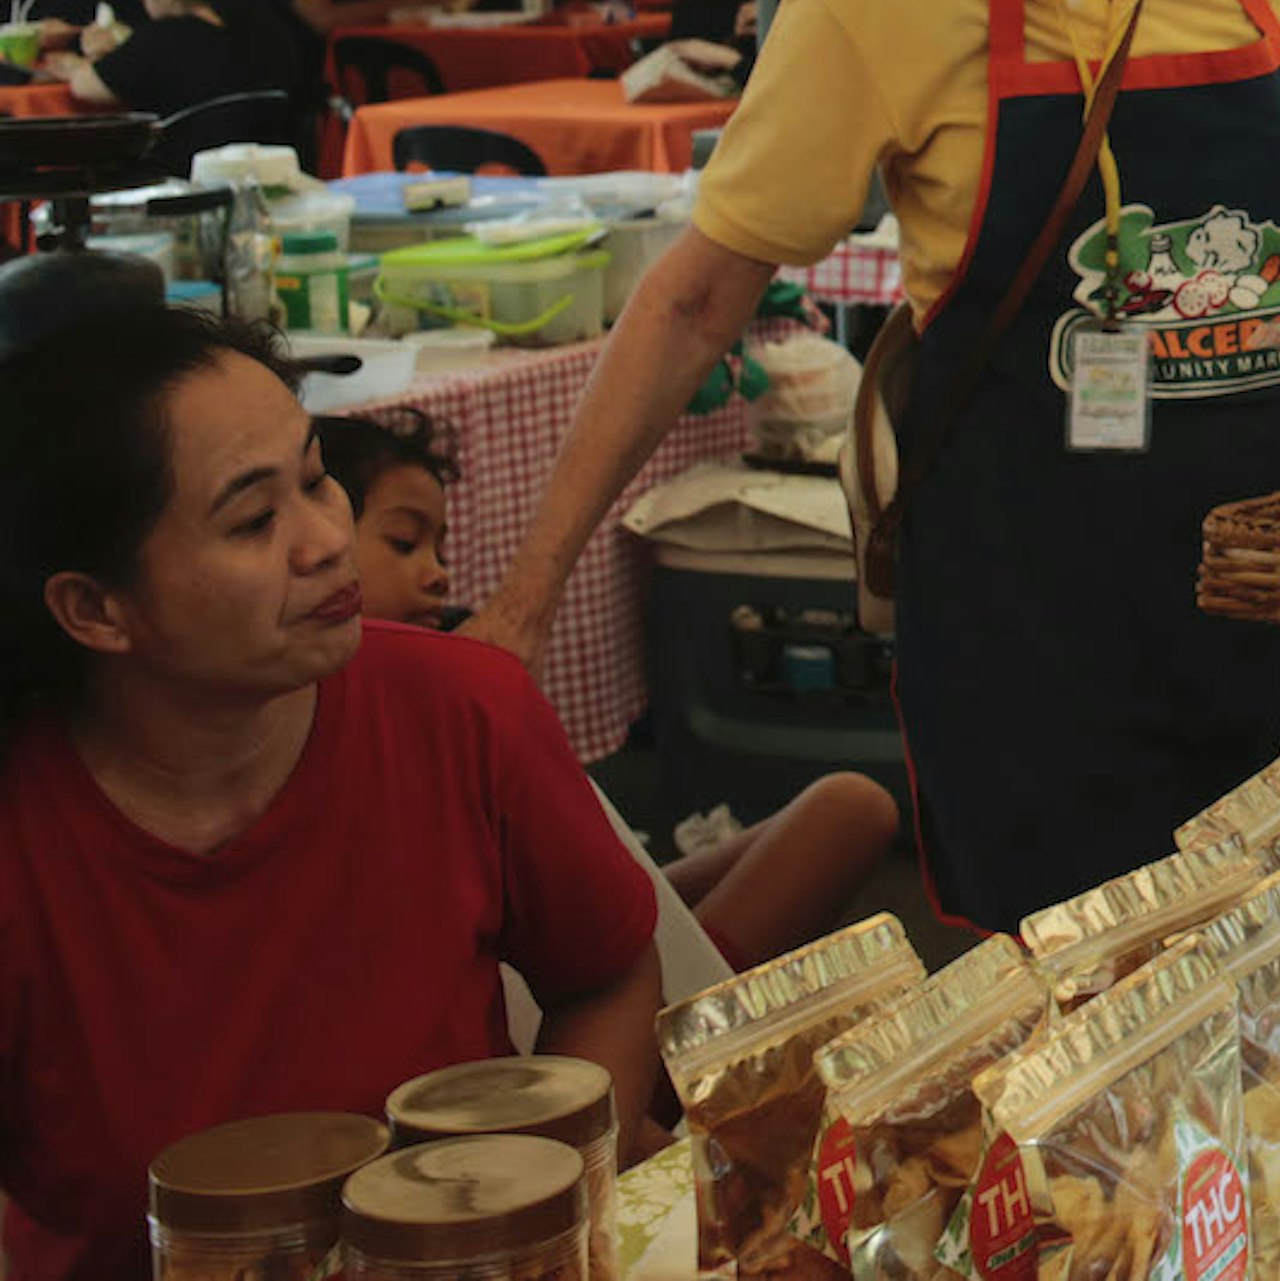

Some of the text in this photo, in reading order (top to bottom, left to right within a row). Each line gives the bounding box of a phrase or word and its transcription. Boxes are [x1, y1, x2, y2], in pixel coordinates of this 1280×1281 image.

[1155, 357, 1231, 379] UNITY
[978, 1166, 1029, 1238] TH
[1184, 1171, 1242, 1259] THC
